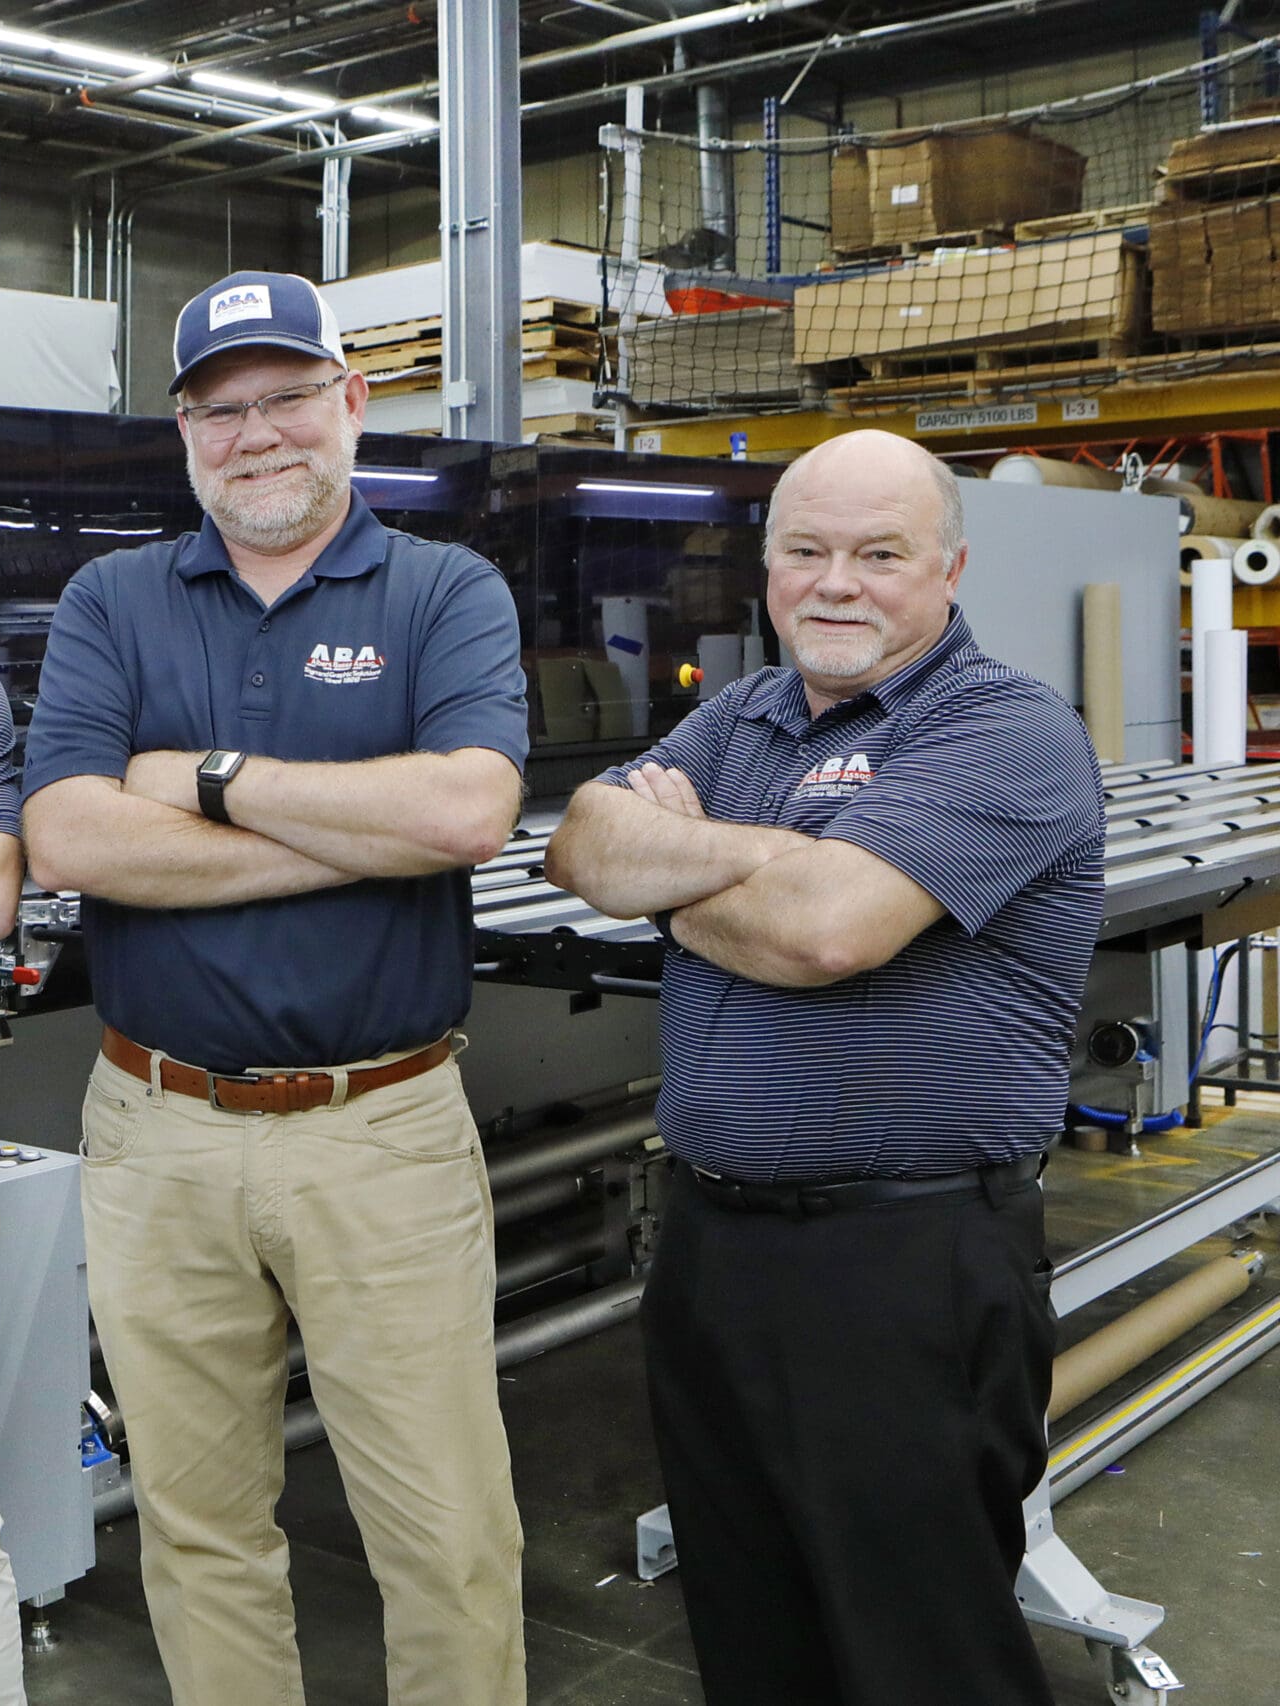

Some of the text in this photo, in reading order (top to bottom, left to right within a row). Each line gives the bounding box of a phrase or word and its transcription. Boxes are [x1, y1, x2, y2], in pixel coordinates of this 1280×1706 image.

[215, 291, 258, 314] ABA
[918, 406, 1035, 428] CAPACITY: 5100 LBS
[306, 643, 378, 671] ABA
